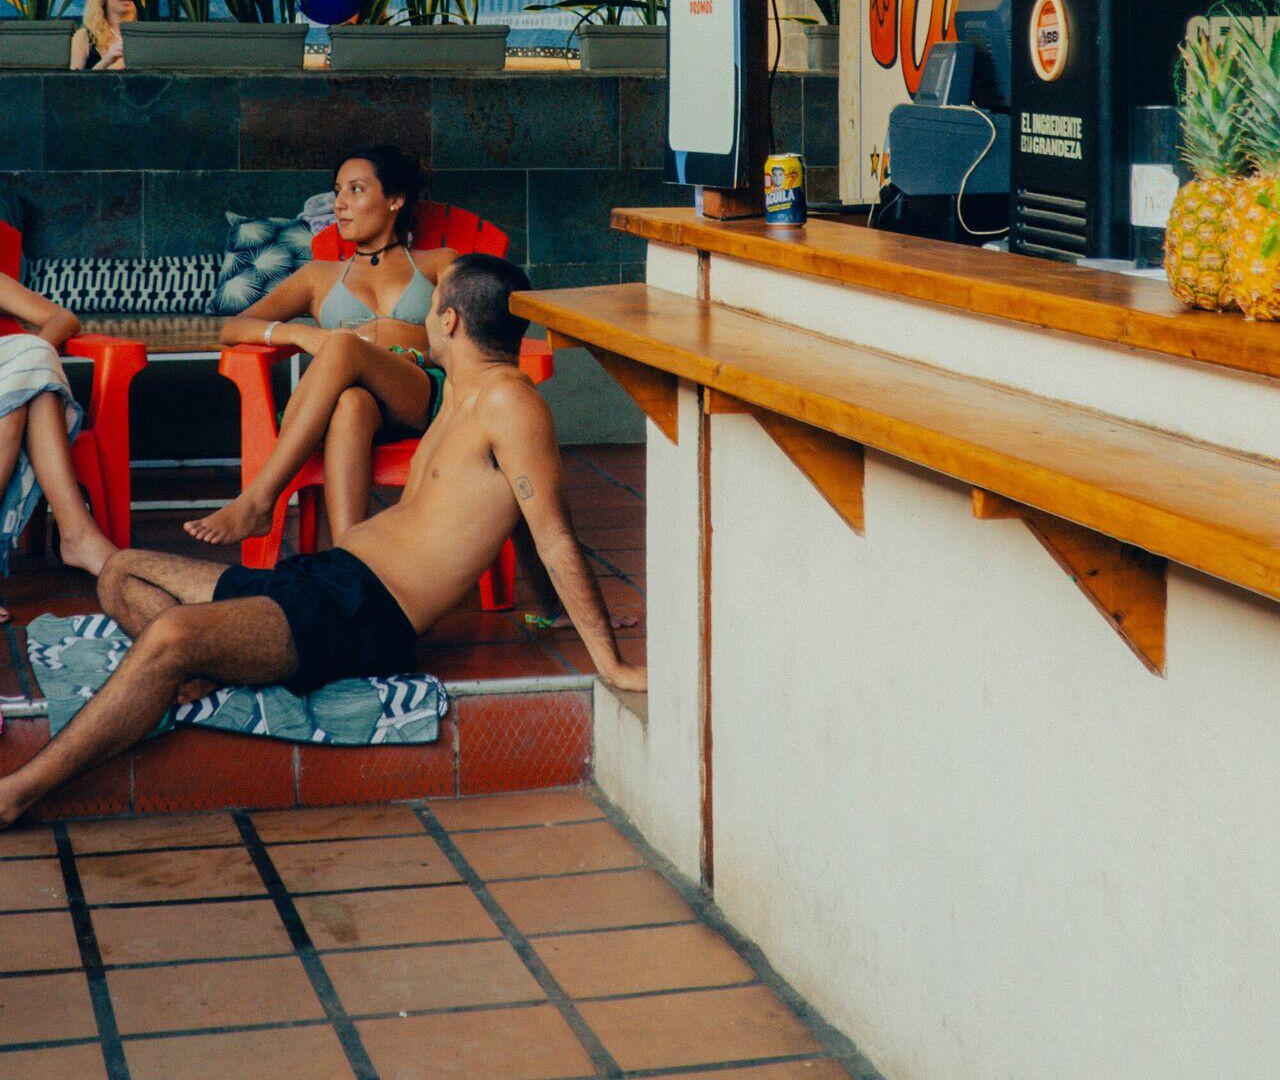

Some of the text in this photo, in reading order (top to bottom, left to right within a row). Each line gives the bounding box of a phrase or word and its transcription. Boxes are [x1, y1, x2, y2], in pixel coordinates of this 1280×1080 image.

[1021, 112, 1082, 139] EL INGREDIENTE
[1033, 136, 1082, 160] GRANDEZA
